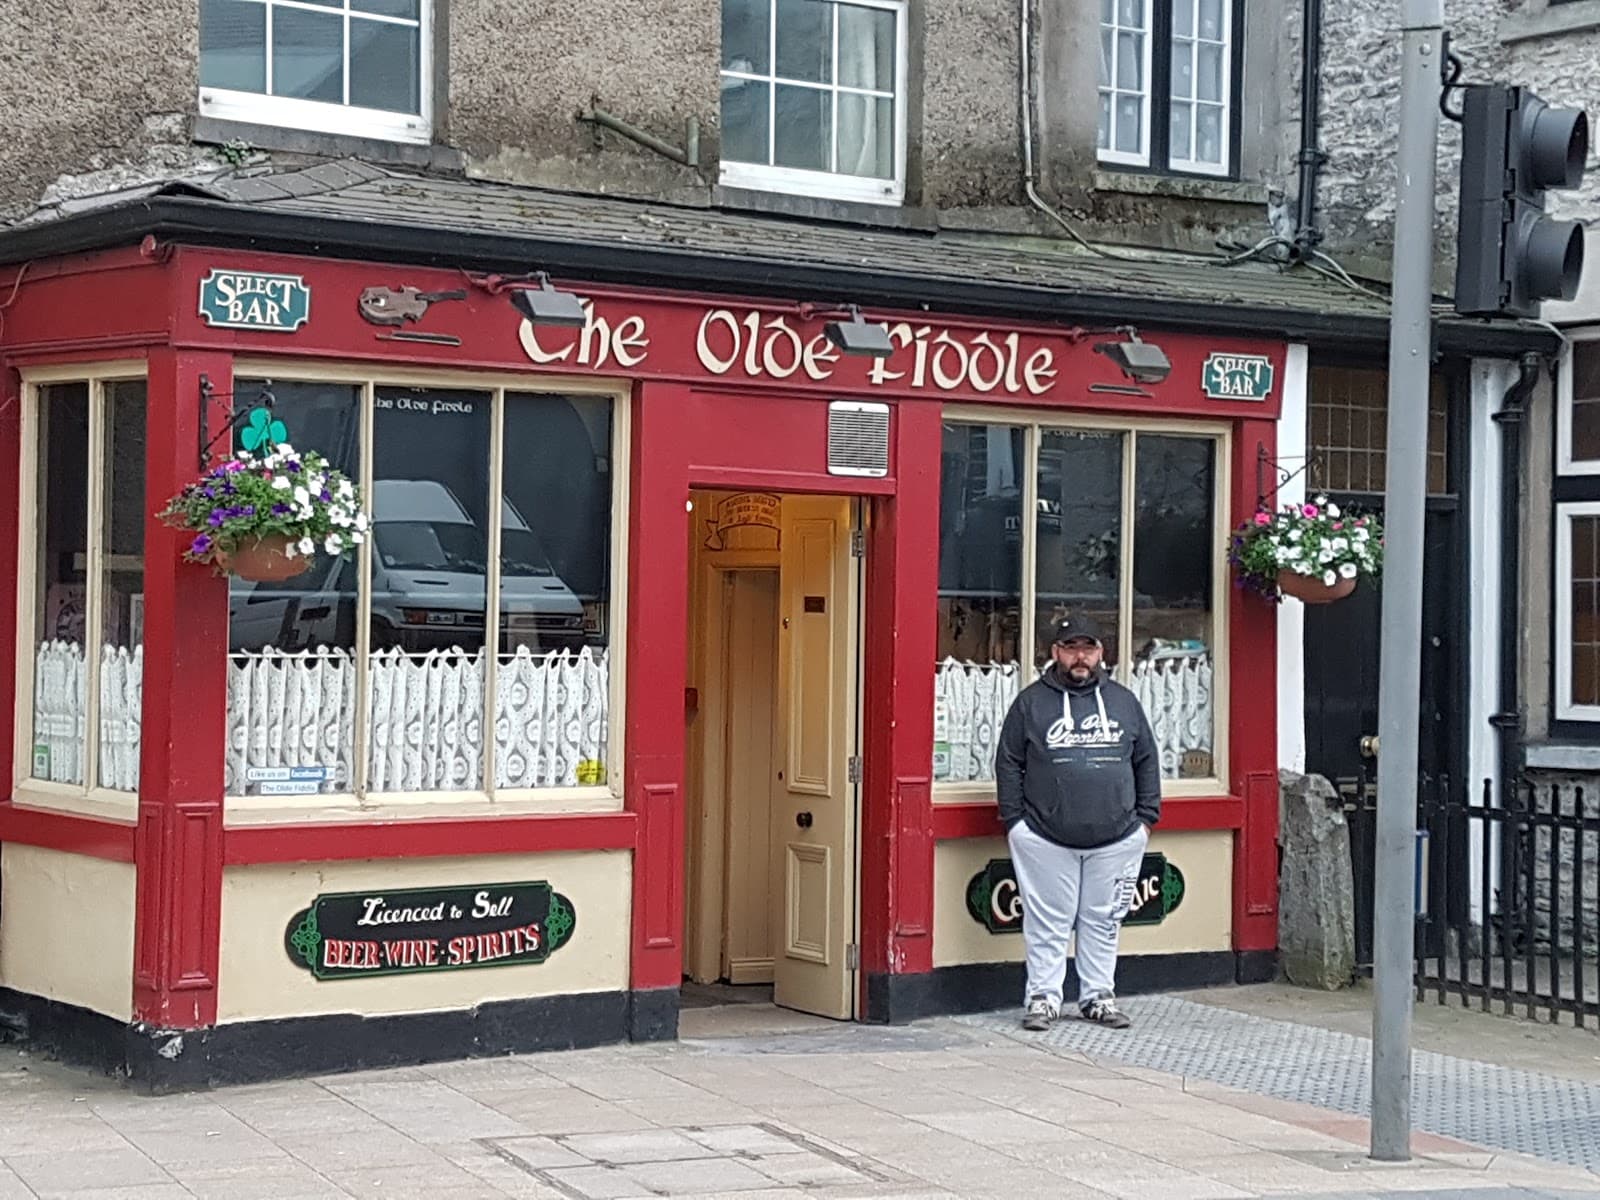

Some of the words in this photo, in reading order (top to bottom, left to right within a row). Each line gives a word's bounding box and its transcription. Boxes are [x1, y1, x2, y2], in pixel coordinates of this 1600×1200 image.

[215, 274, 297, 312] SELECT
[227, 297, 283, 325] BAR
[696, 308, 840, 380] Olde
[1211, 357, 1265, 385] SELECT
[1219, 374, 1255, 396] BAR
[357, 897, 445, 926] Licenced
[450, 907, 463, 920] to
[471, 891, 514, 919] Sell
[448, 923, 542, 966] SPIRITS
